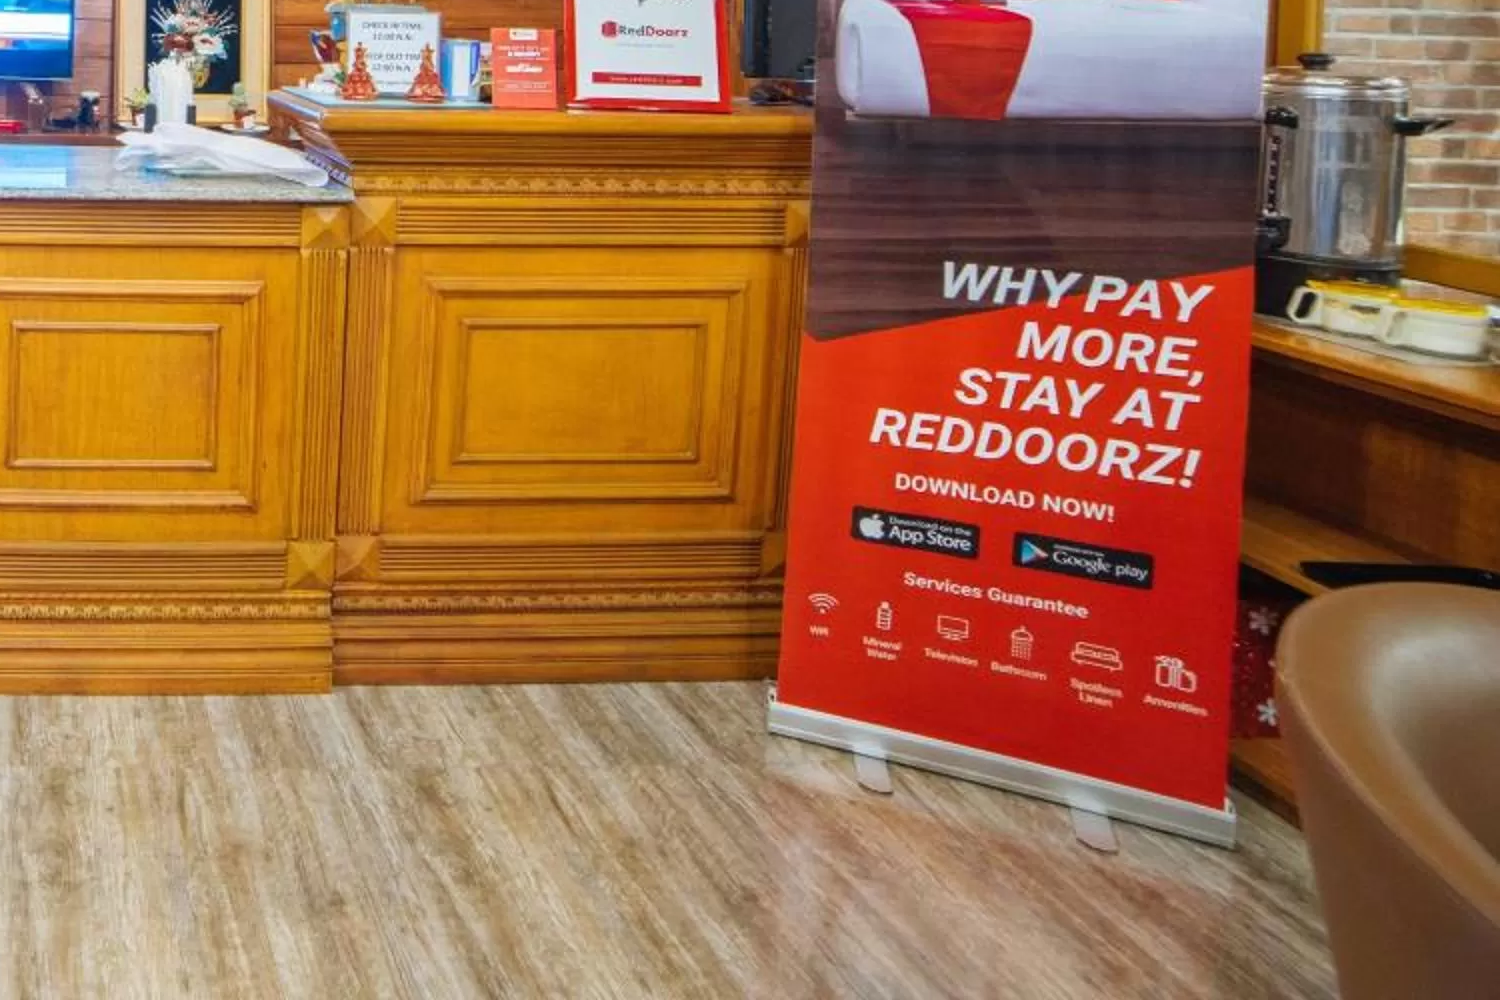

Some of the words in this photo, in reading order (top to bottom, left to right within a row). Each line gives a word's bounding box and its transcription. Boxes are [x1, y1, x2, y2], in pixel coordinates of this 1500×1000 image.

[943, 261, 1082, 308] WHY
[1085, 275, 1214, 324] PAY
[1016, 321, 1204, 387] MORE,
[955, 367, 1105, 419] STAY
[1113, 388, 1201, 432] AT
[869, 407, 1203, 489] REDDOORZ!
[895, 472, 1035, 510] DOWNLOAD
[1041, 495, 1115, 523] NOW!
[889, 527, 924, 545] App
[927, 530, 972, 551] Store
[1052, 551, 1111, 575] Google
[1115, 562, 1149, 582] play
[904, 571, 983, 599] Services
[987, 587, 1089, 618] Guarantee
